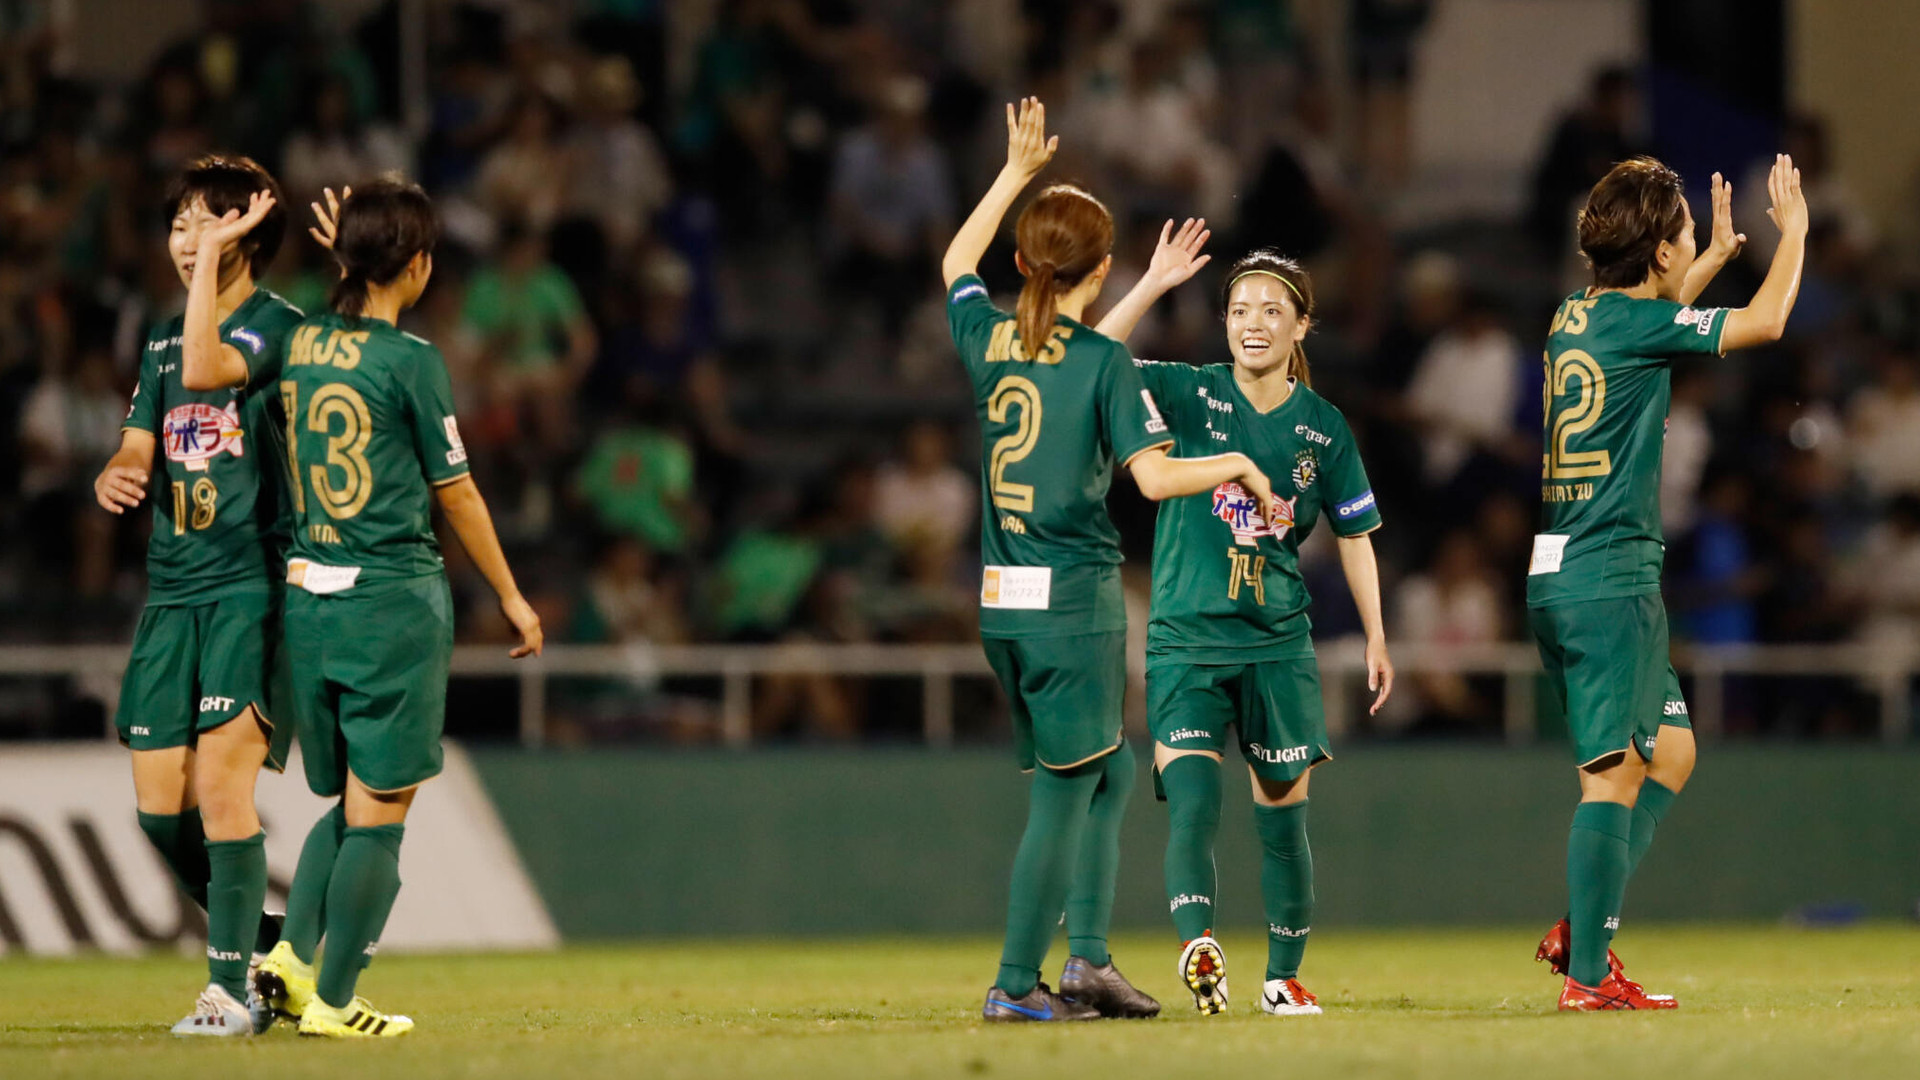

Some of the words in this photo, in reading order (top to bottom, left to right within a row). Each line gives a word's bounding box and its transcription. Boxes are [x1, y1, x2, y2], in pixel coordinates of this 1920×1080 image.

[1549, 299, 1598, 335] JS
[287, 325, 370, 370] MJS
[280, 381, 373, 519] 13
[988, 375, 1043, 513] 2
[172, 477, 217, 536] 18
[1227, 547, 1265, 606] 14
[1250, 743, 1309, 763] SYLIGHT
